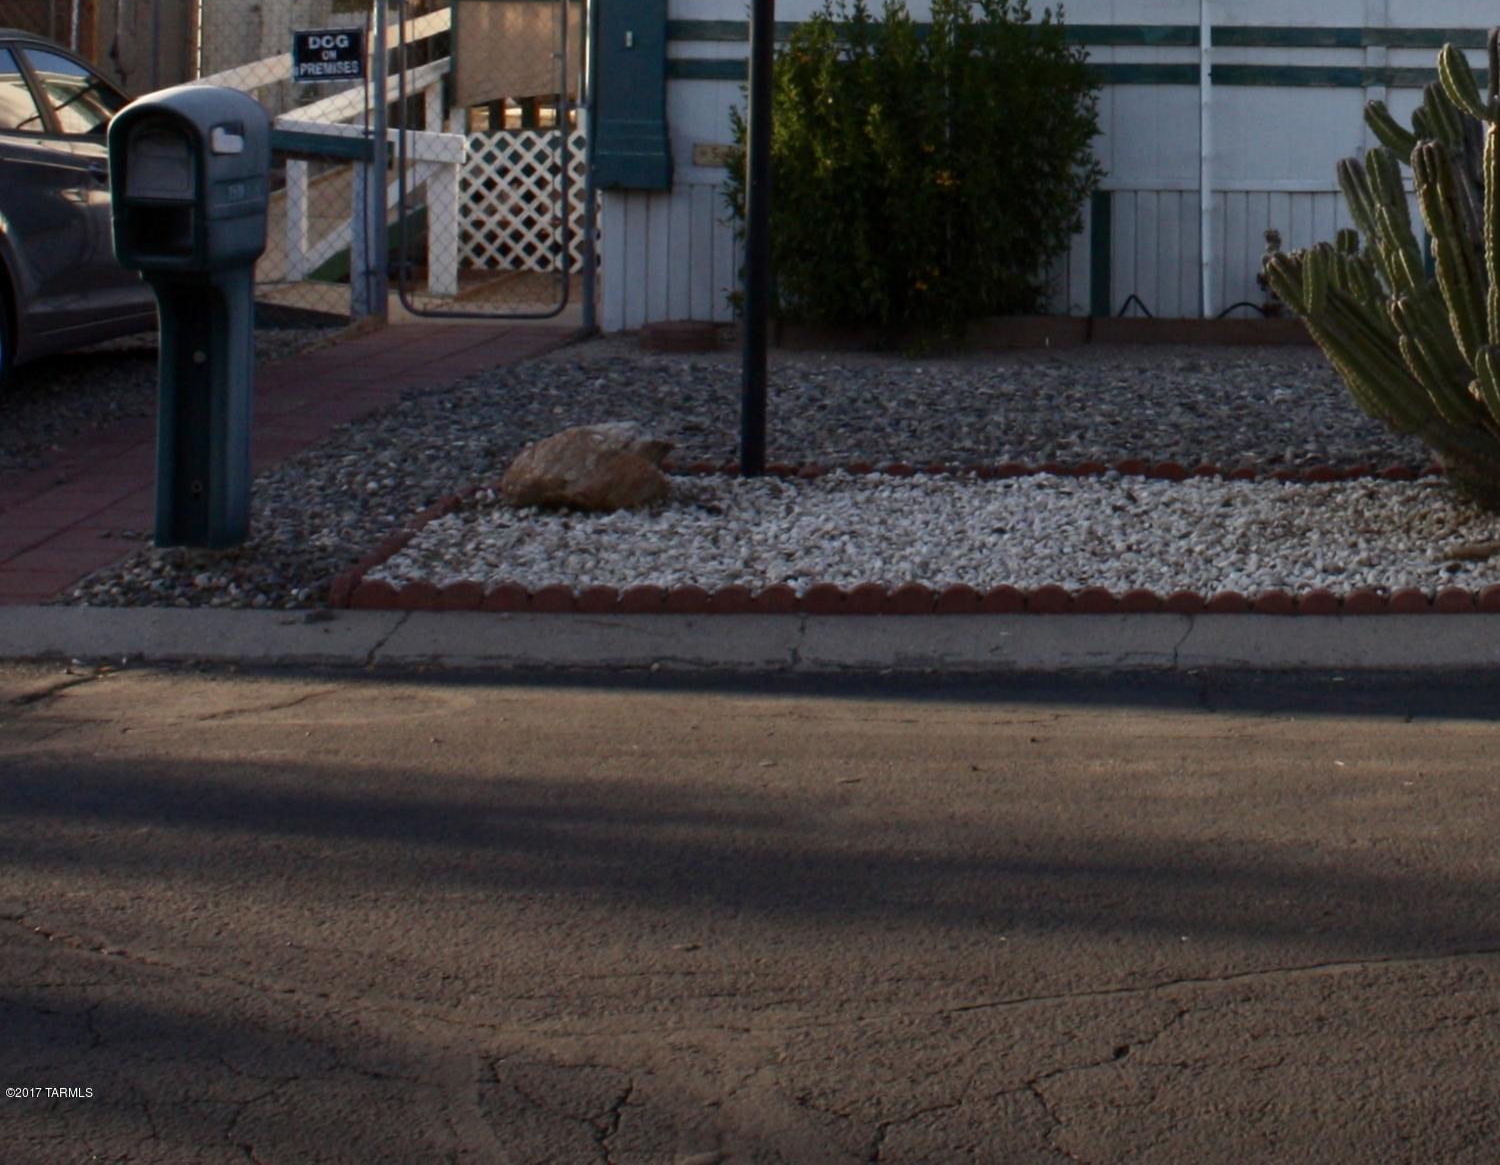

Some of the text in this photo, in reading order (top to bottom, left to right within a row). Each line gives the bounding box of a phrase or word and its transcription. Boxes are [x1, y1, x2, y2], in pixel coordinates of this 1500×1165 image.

[308, 35, 349, 49] DOG
[321, 50, 337, 61] ON
[300, 61, 359, 76] PREMISES
